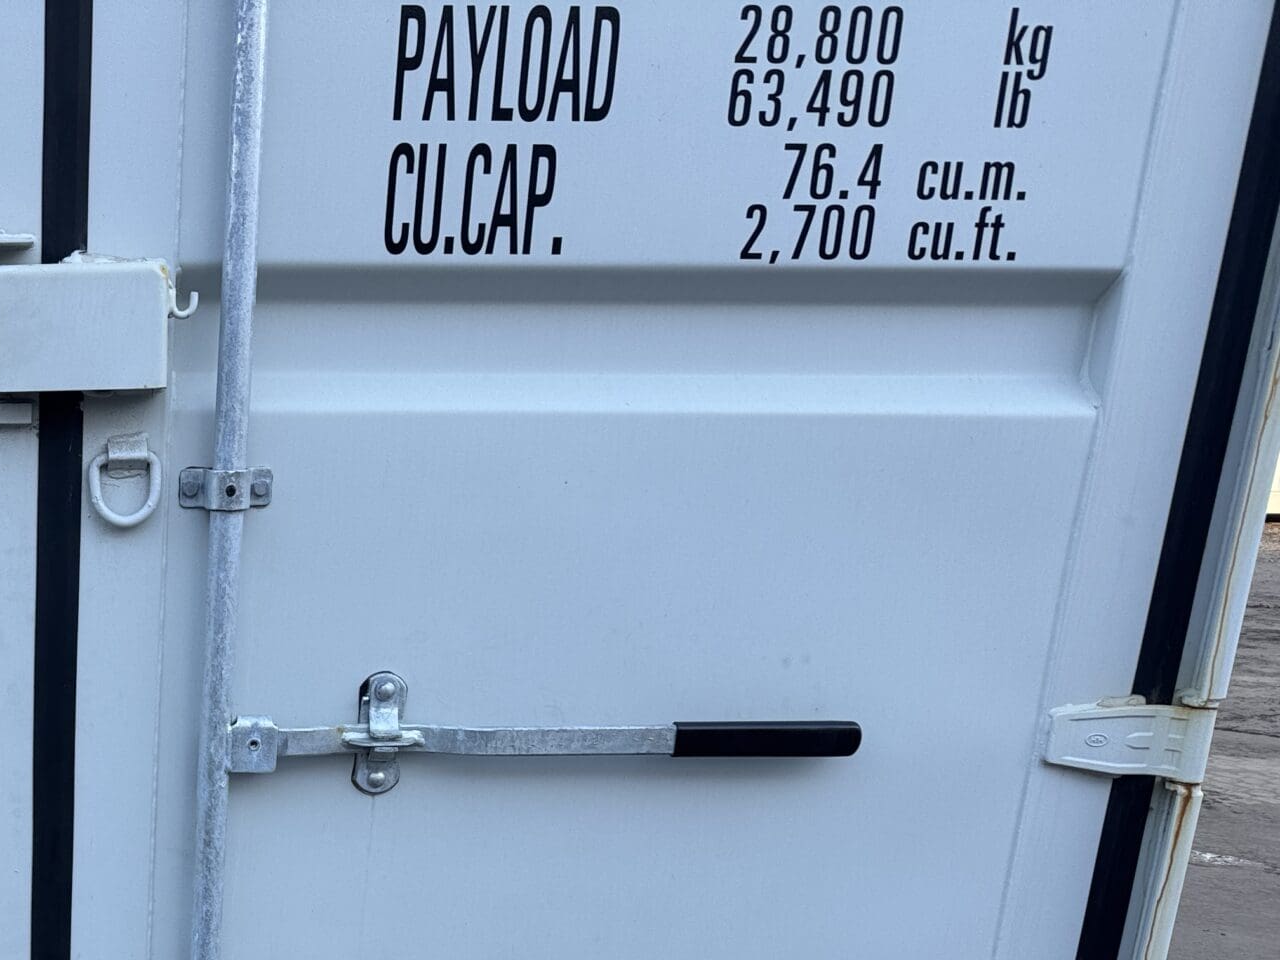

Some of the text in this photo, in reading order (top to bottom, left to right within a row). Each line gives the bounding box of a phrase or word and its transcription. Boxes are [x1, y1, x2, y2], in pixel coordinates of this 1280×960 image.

[393, 4, 1053, 122] PAYLOAD 28,800 kg
[727, 69, 1031, 131] 63,490 lb
[384, 142, 1027, 256] CU.CAP. 76.4 cu.m.
[739, 204, 1016, 264] 2,700 cu.ft.
